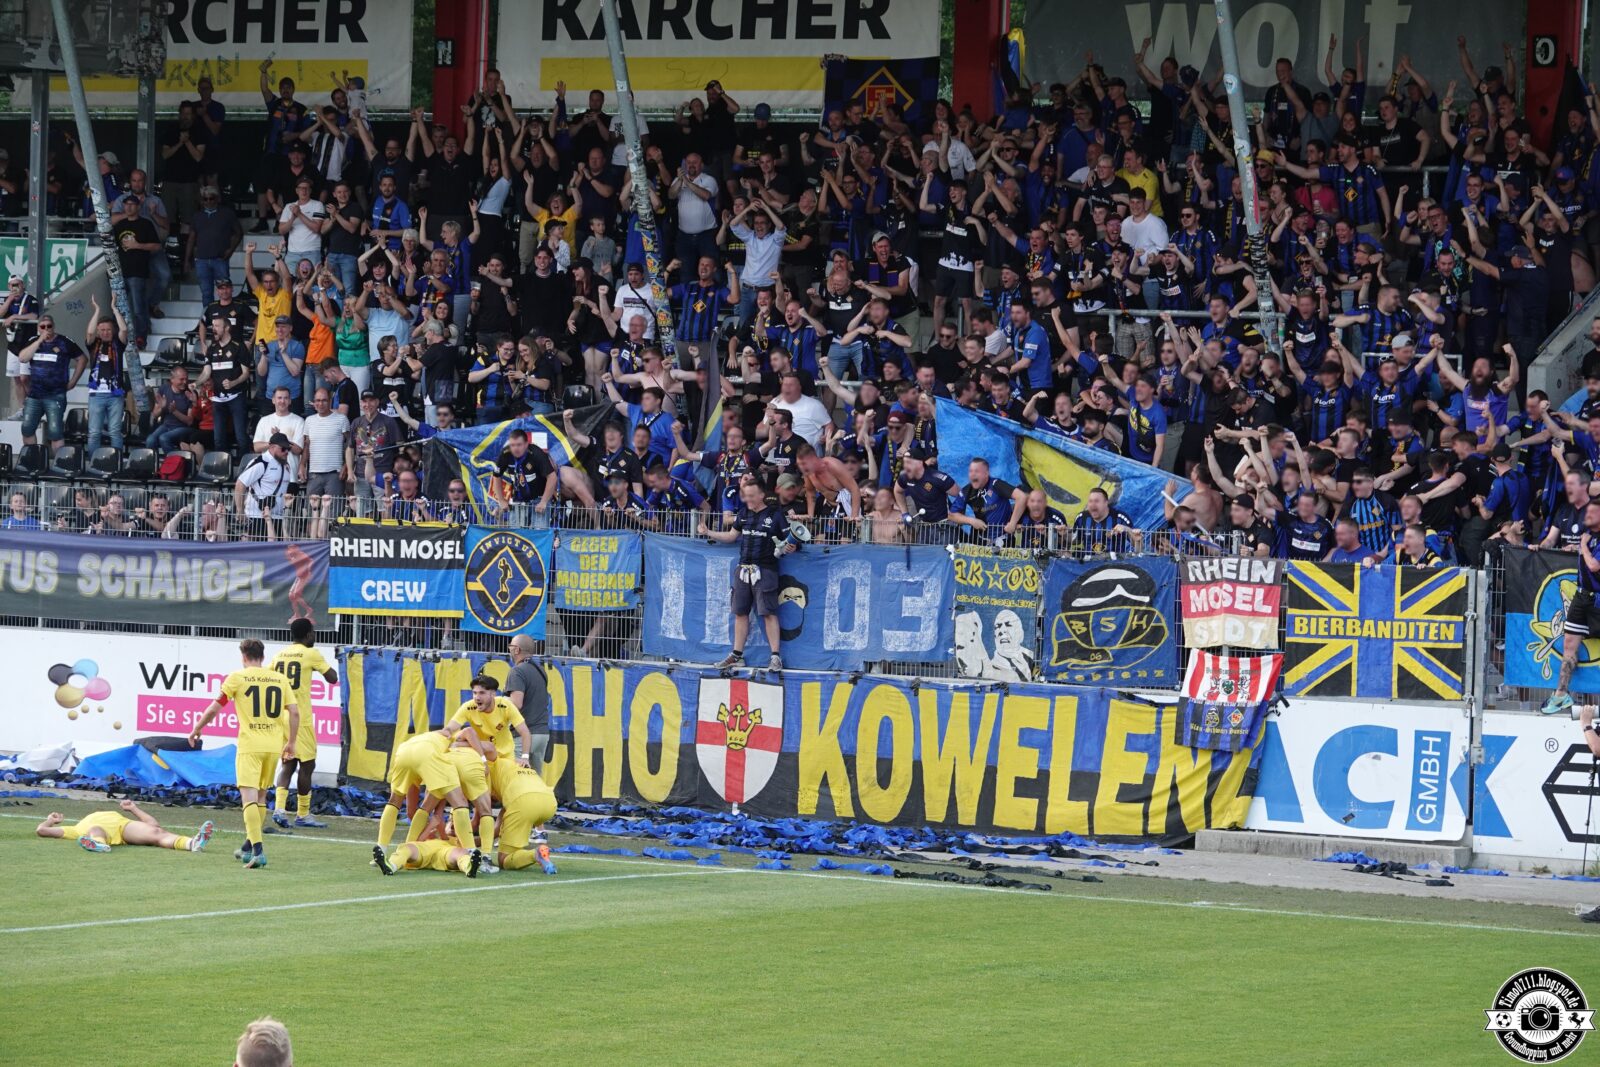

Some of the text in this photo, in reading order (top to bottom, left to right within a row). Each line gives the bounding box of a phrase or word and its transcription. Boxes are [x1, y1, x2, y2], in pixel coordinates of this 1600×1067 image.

[165, 0, 368, 44] RCHER
[1378, 394, 1396, 402] LOTTO
[330, 537, 464, 560] RHEIN MOSEL
[479, 536, 534, 559] INVICTUS
[570, 536, 619, 553] GEGEN
[579, 553, 609, 571] DEN
[1187, 558, 1276, 584] RHEIN
[77, 550, 273, 604] SCHÄNGEL
[557, 570, 636, 590] MODERNEN
[360, 580, 427, 603] CREW
[1189, 583, 1273, 613] MOSEL
[488, 615, 516, 628] 2021
[1294, 615, 1455, 641] BIERBANDITEN
[244, 685, 282, 719] 10
[145, 703, 176, 725] Sie
[182, 709, 239, 731] spare
[1416, 735, 1442, 825] GMBH
